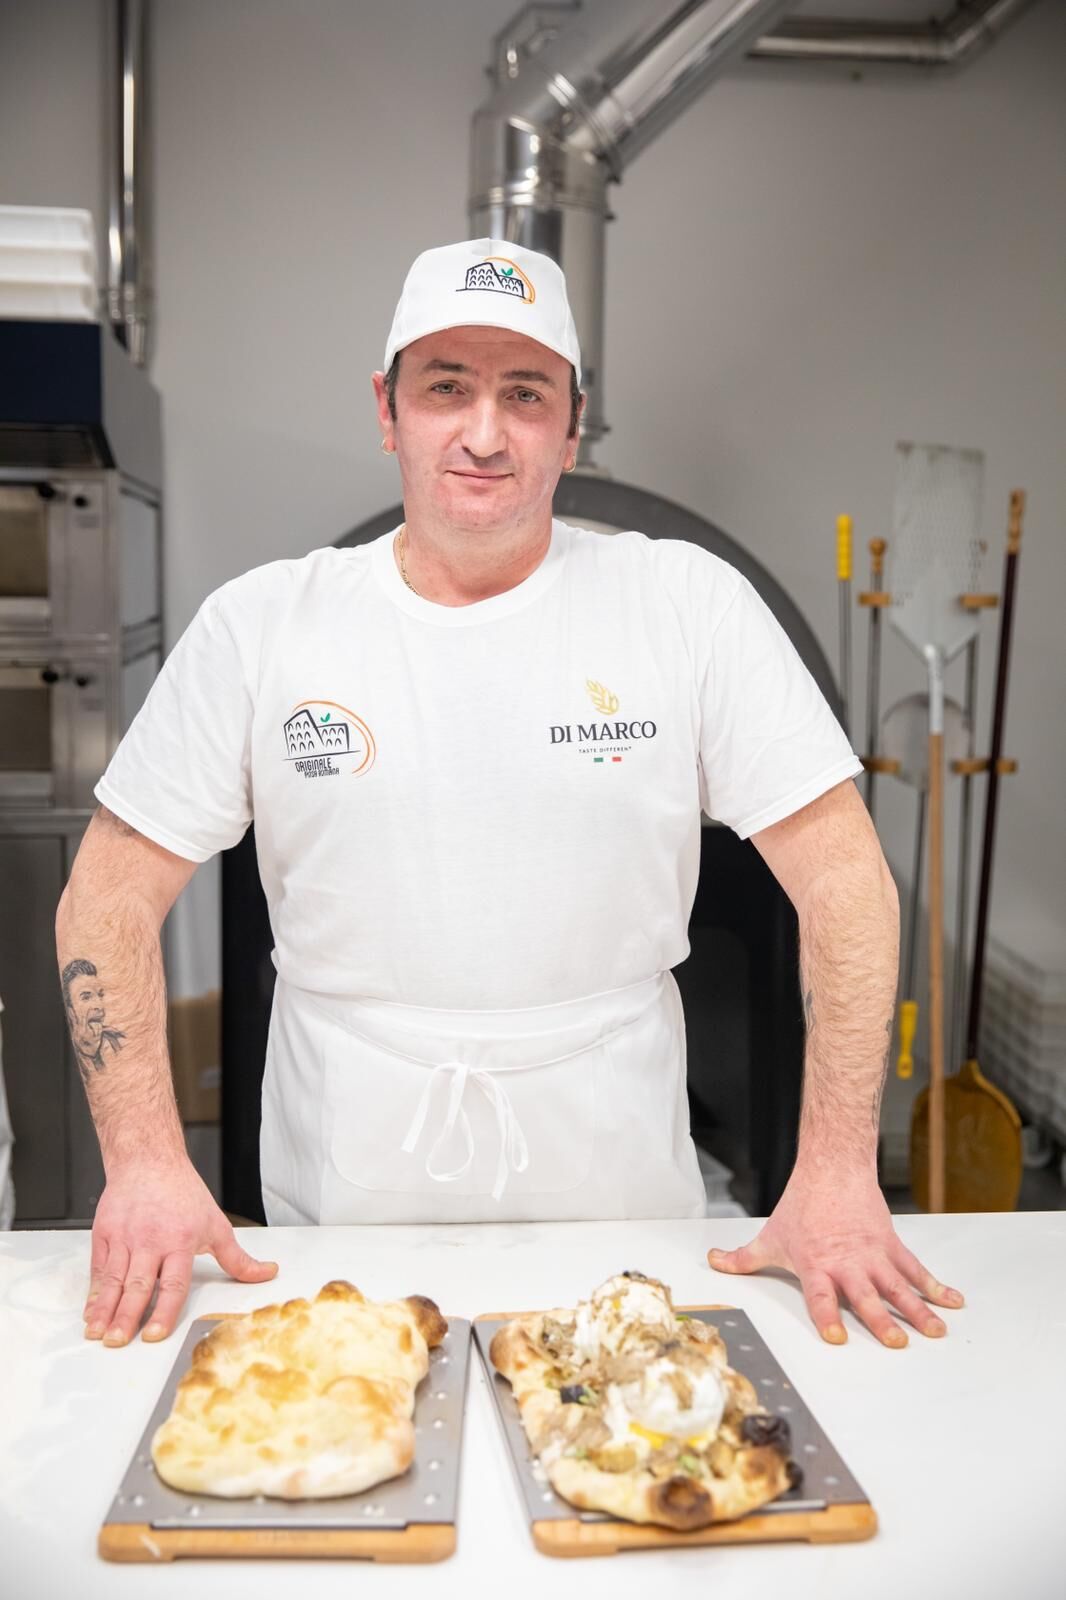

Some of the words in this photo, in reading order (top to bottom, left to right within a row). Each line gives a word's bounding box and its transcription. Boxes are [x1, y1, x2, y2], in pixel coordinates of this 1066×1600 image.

[549, 725, 573, 744] DI
[577, 720, 657, 742] MARCO
[294, 757, 332, 773] ORIGINALE
